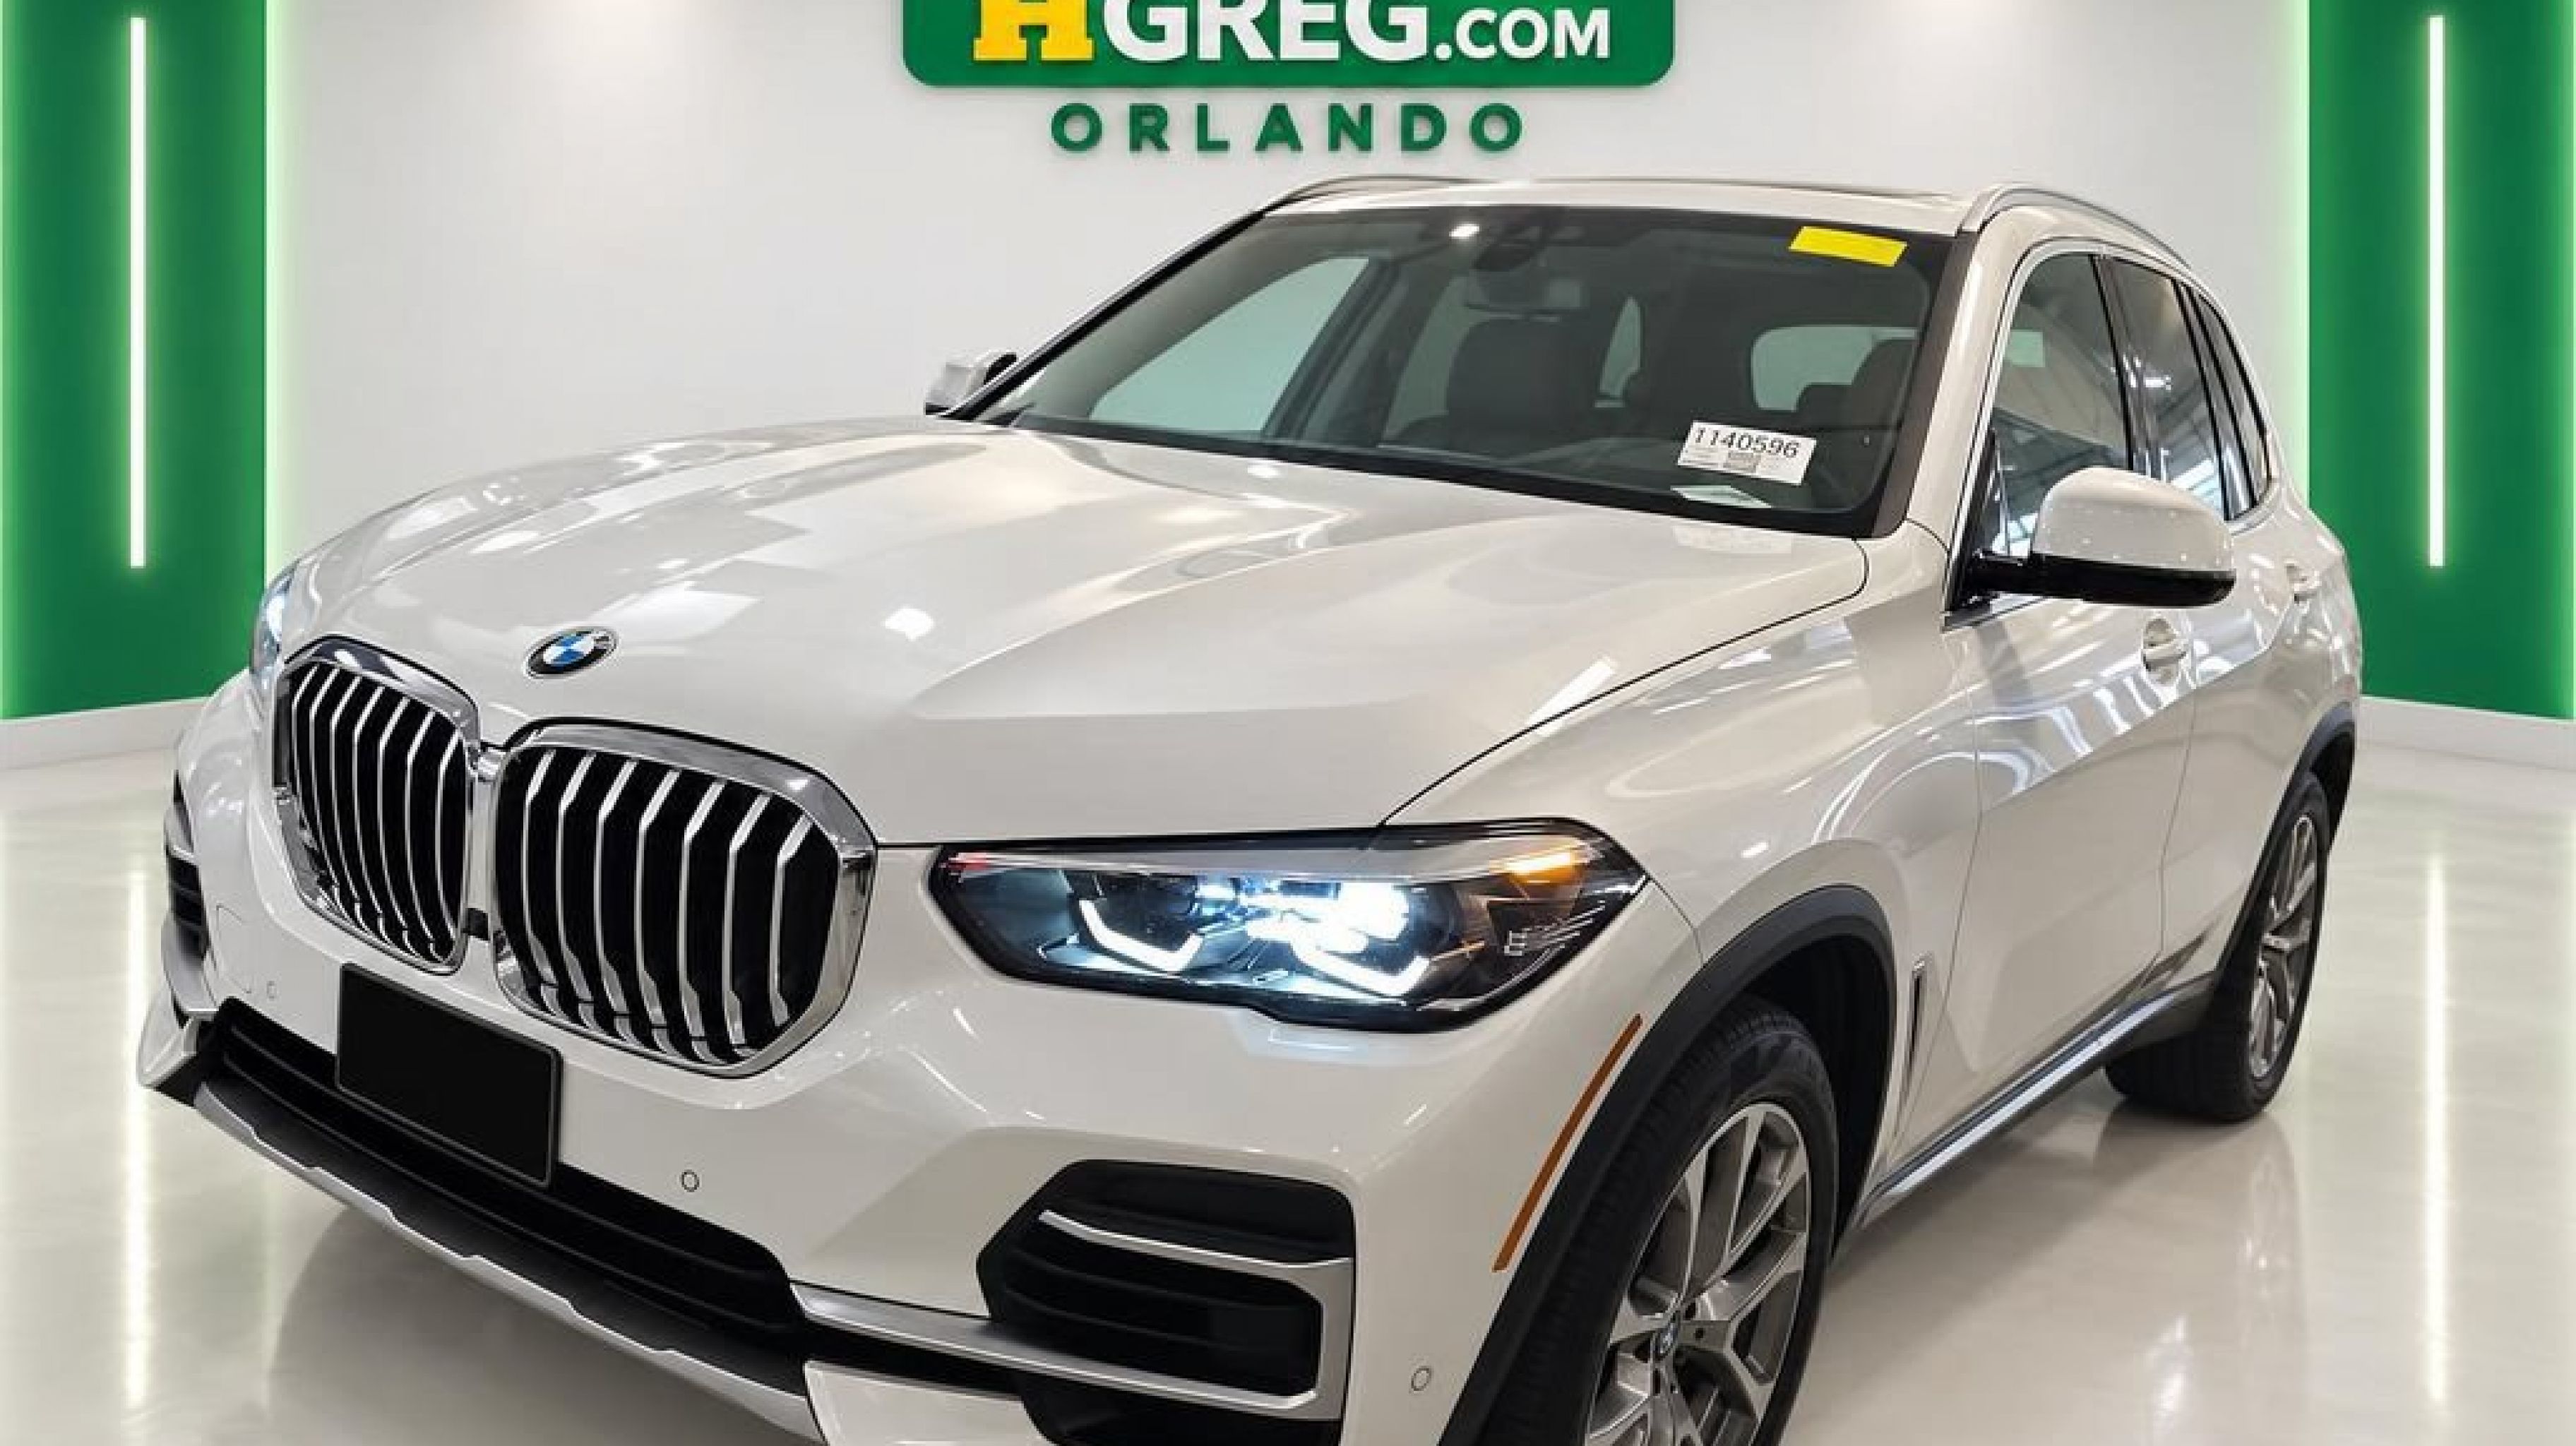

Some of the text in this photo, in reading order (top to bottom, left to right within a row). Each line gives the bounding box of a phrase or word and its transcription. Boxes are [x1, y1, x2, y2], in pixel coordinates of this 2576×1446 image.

[974, 0, 1611, 61] HGREG.COM
[1051, 102, 1522, 153] ORLANDO
[1695, 427, 1800, 458] 1140596
